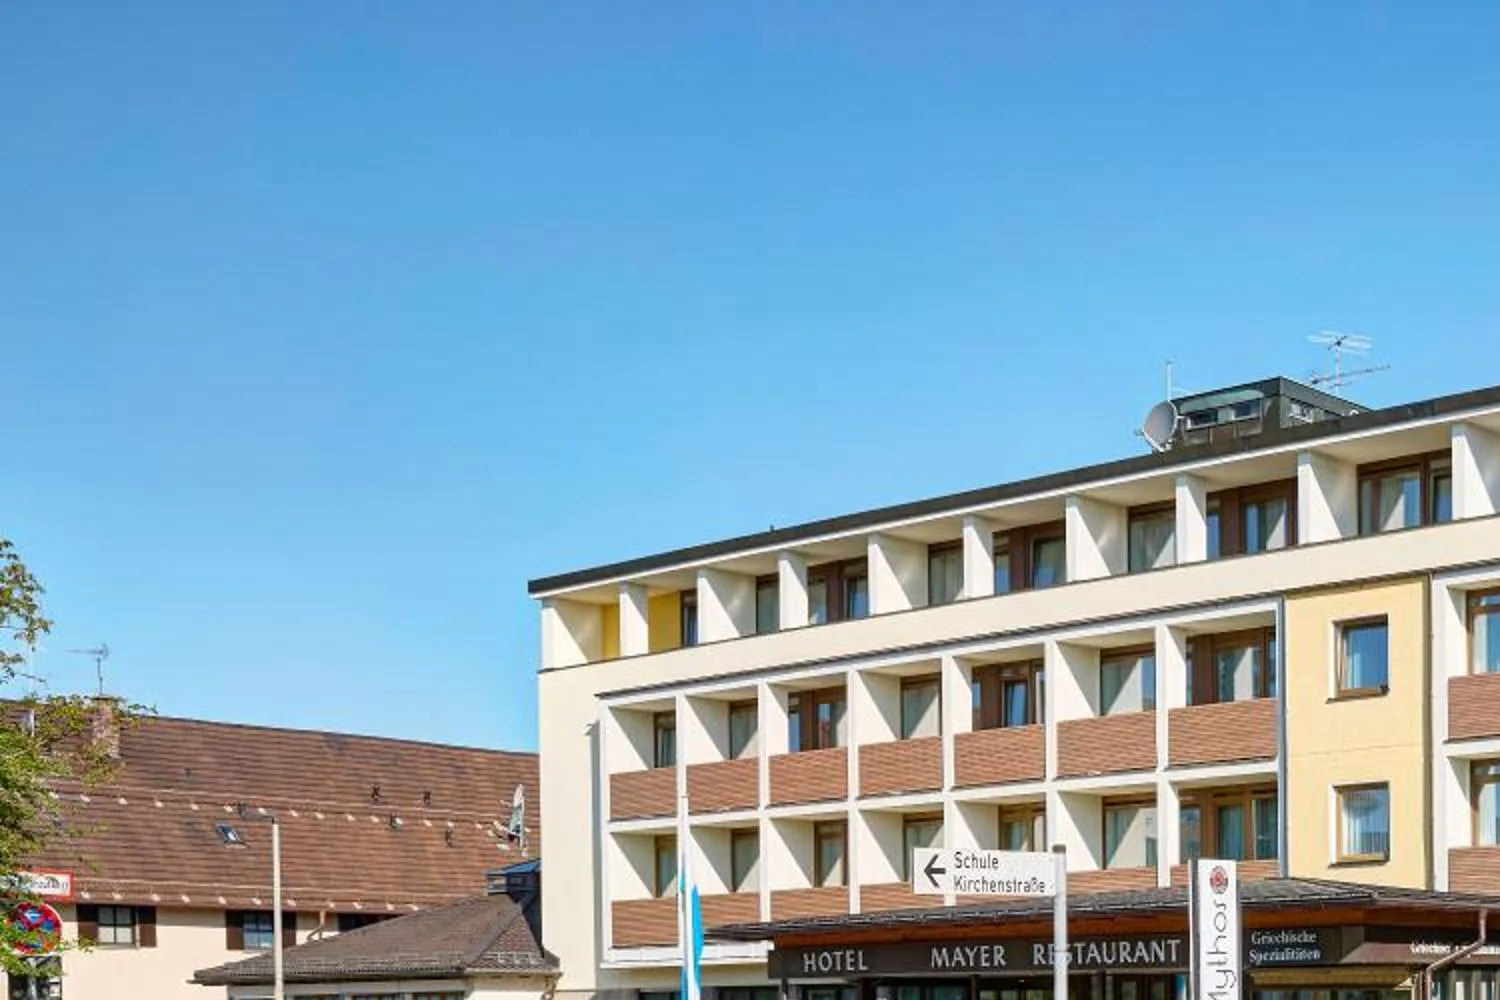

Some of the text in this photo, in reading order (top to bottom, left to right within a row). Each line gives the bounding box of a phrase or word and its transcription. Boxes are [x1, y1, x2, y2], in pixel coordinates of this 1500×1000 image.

[954, 851, 999, 869] Schule
[953, 875, 1045, 893] Kirchenstraße
[803, 950, 868, 973] HOTEL
[931, 944, 1007, 969] MAYER
